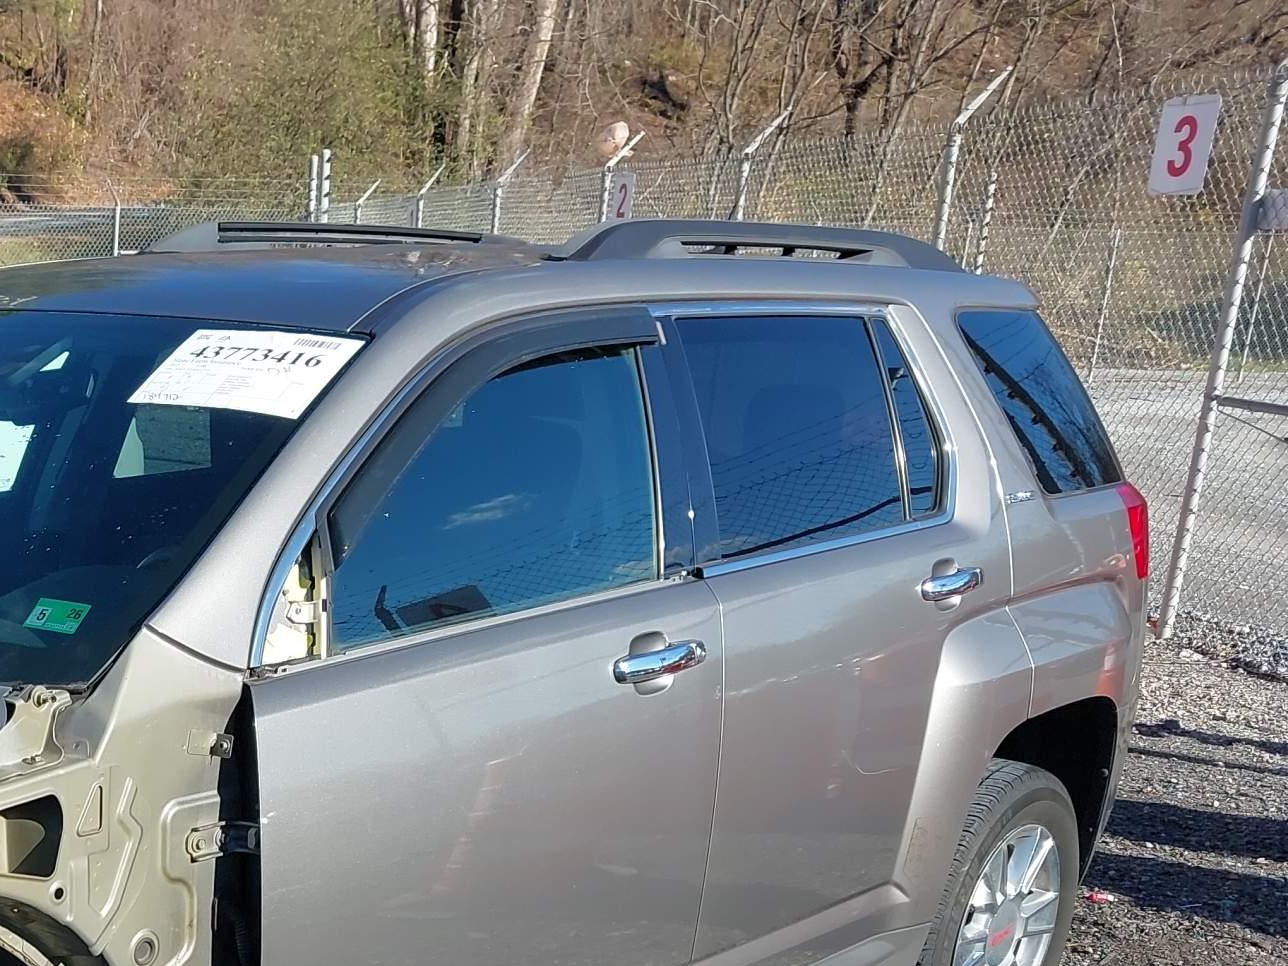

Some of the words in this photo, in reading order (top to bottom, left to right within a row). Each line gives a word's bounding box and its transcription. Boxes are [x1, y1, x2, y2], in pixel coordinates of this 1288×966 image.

[1167, 115, 1198, 178] 3
[616, 183, 628, 218] 2
[189, 345, 326, 368] 43773416
[37, 608, 49, 621] 5
[66, 608, 83, 620] 26
